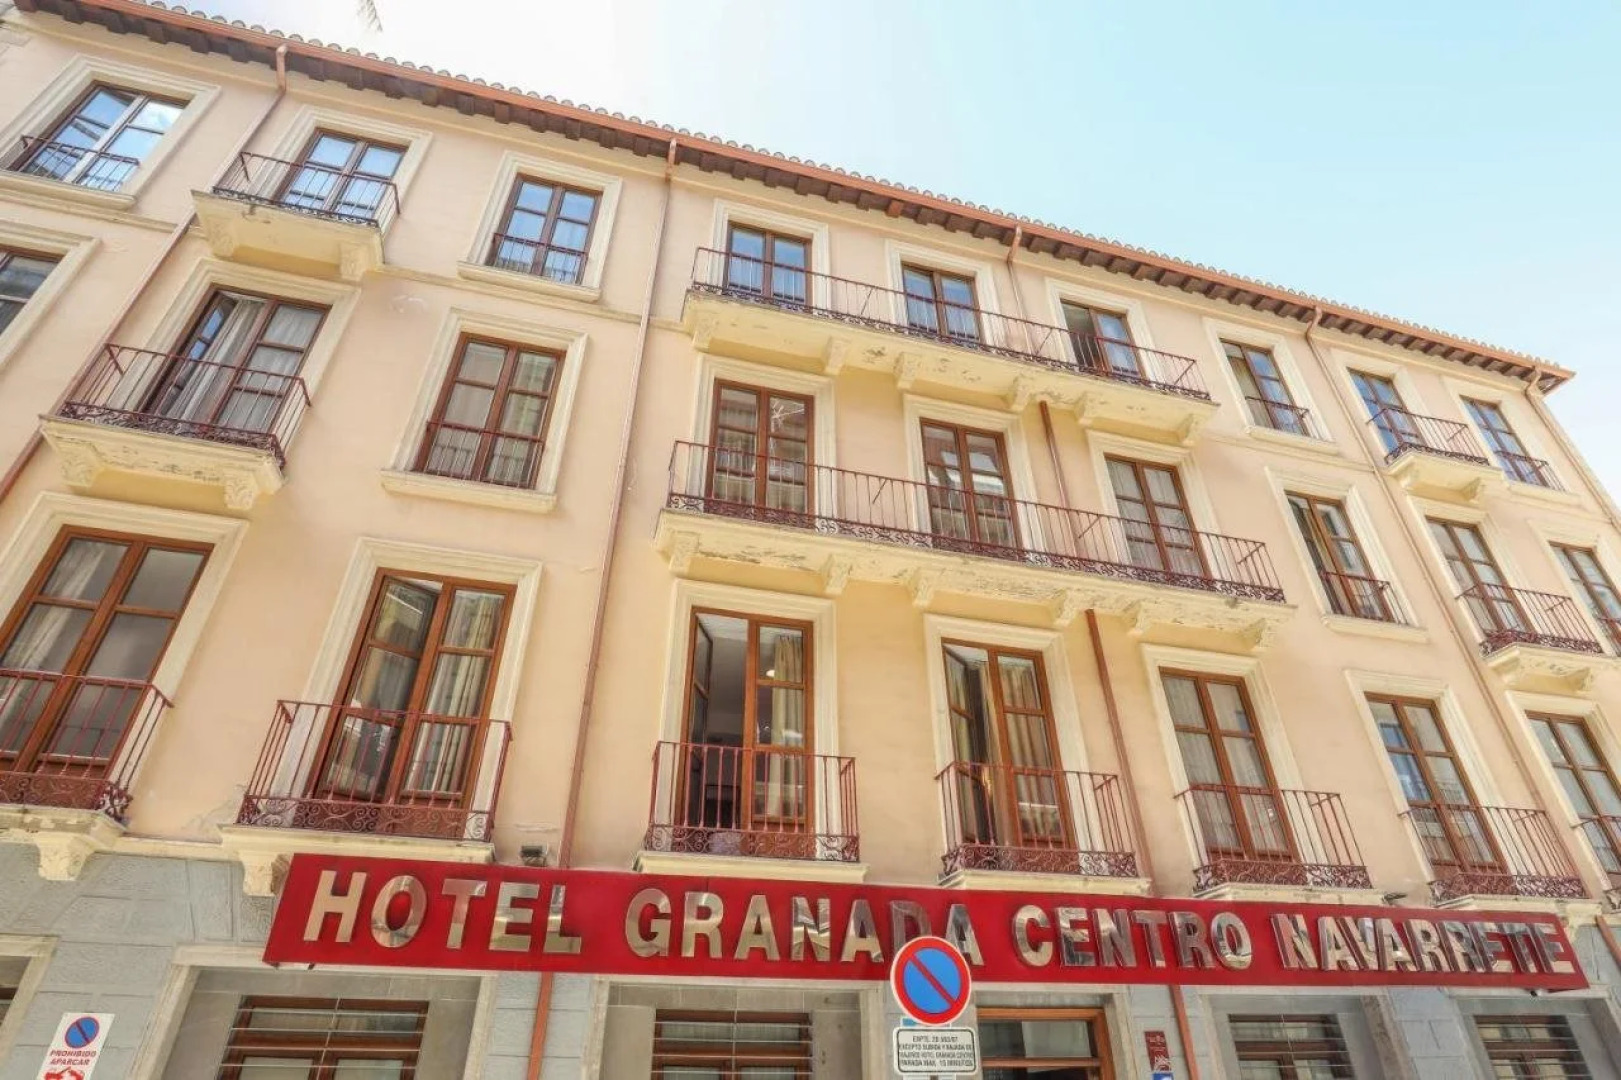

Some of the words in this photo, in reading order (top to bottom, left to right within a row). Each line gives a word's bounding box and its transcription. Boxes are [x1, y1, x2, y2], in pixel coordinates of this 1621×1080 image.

[303, 869, 582, 954] HOTEL
[625, 888, 984, 966] GRANADA
[1013, 904, 1252, 970] CENTRO
[1270, 913, 1575, 973] NAVARRETE
